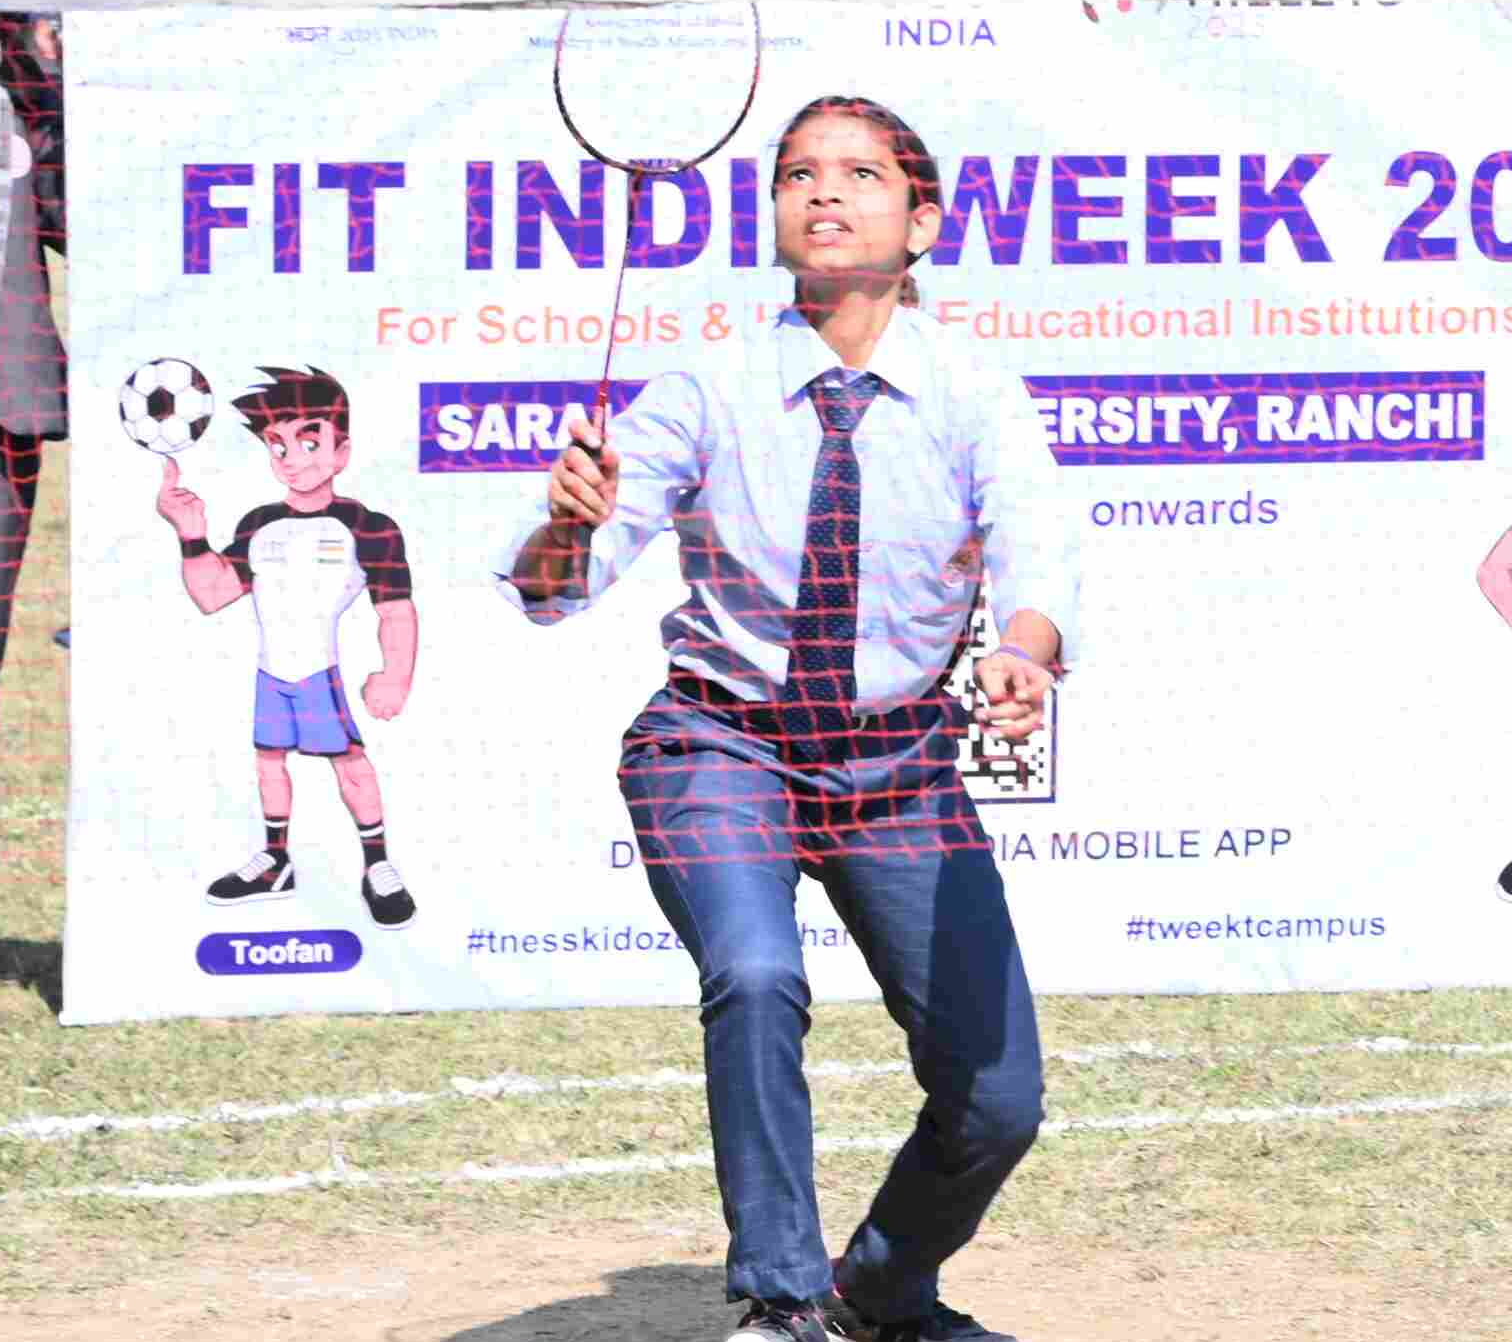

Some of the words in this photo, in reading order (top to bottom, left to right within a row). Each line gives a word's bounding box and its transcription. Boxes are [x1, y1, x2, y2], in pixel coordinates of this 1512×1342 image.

[885, 18, 997, 46] INDIA
[181, 162, 406, 275] FIT
[465, 156, 759, 272] INDI
[930, 153, 1334, 266] WEEK
[376, 305, 460, 346] For
[475, 301, 682, 345] Schools
[700, 302, 732, 341] &
[1031, 396, 1239, 453] ERSITY,
[1256, 392, 1473, 442] RANCHI
[1090, 492, 1280, 528] onwards
[1050, 829, 1202, 860] MOBILE
[1214, 828, 1293, 857] APP
[1125, 913, 1386, 942] #tweektcampus
[228, 937, 334, 965] Toofan
